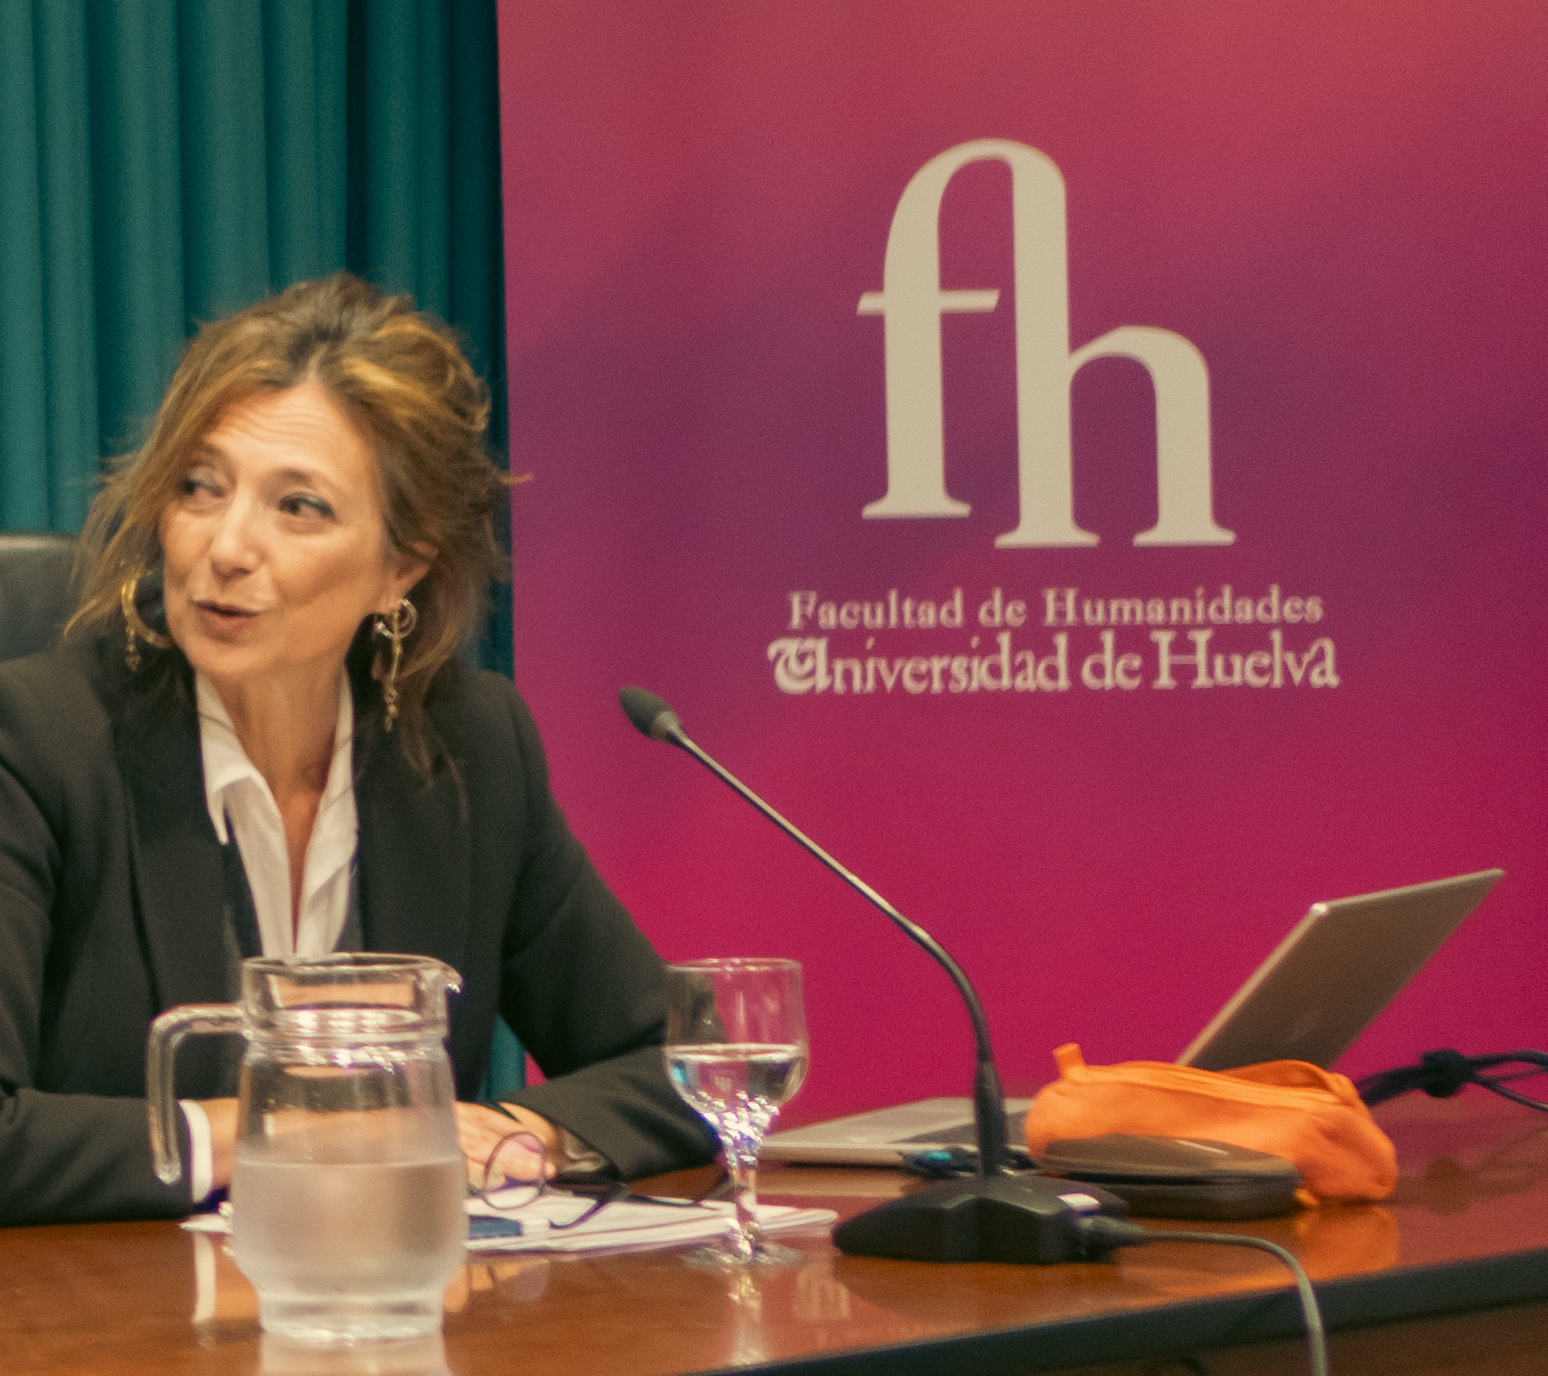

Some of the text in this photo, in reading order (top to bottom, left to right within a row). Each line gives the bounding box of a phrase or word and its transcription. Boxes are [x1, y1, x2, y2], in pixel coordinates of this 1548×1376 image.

[857, 136, 1237, 550] fh
[787, 583, 1324, 630] Facultad de Humanidades
[767, 628, 1341, 695] Universidad de Huelva
